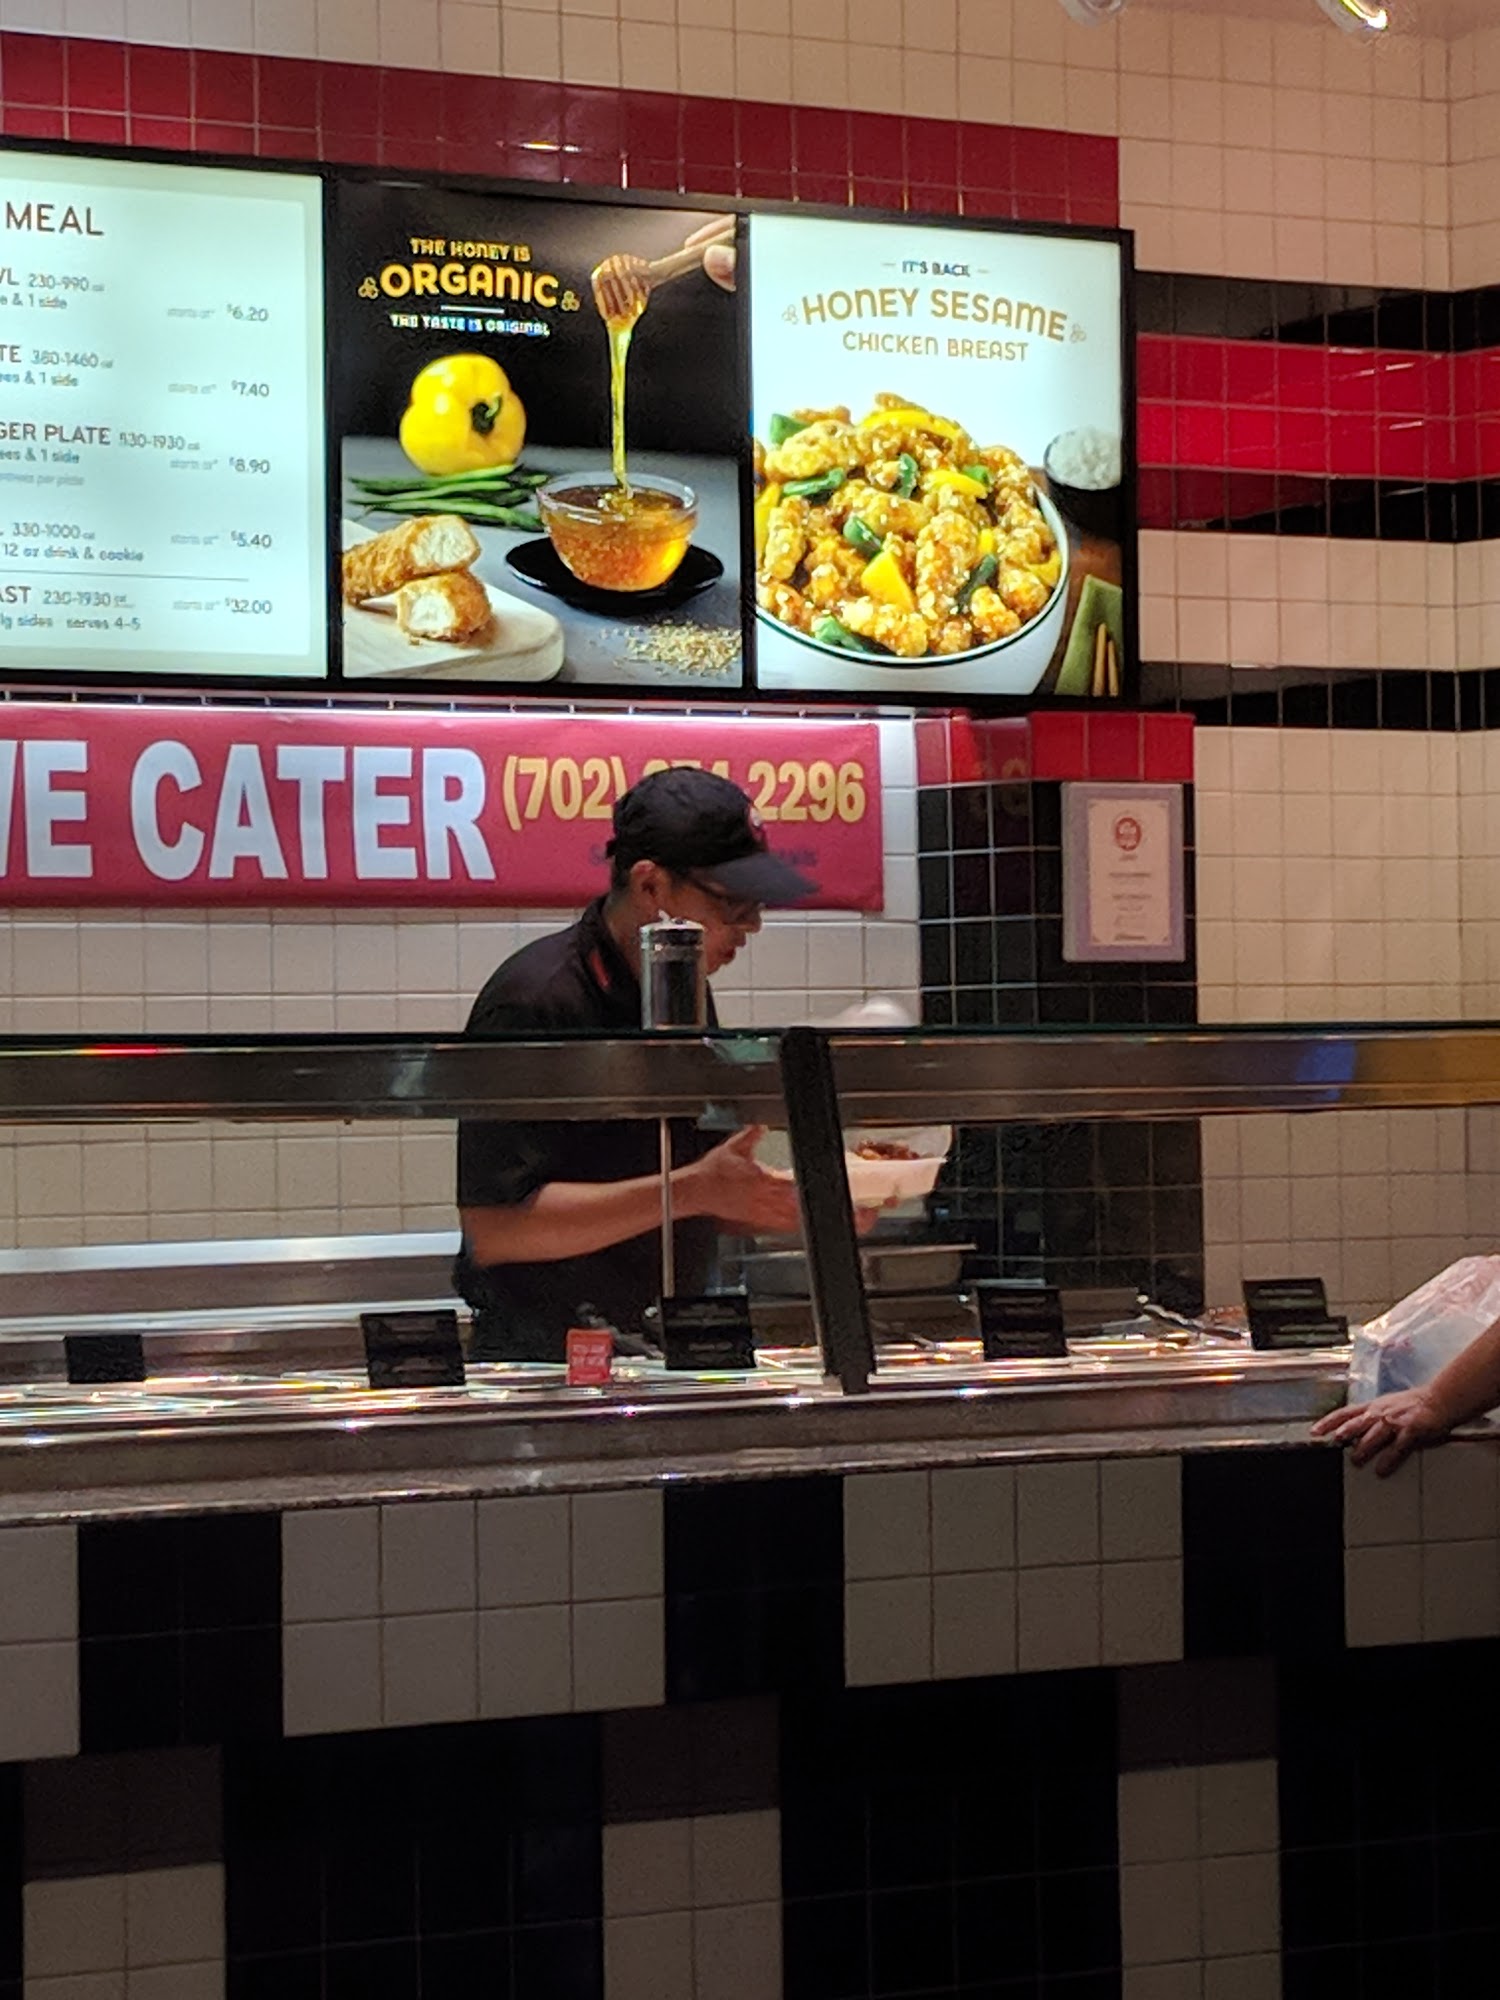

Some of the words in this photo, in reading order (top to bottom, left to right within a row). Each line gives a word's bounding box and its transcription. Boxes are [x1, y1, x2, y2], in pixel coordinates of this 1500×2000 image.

[5, 201, 105, 236] MEAL
[410, 237, 446, 257] THE
[450, 240, 511, 261] HONEY
[513, 245, 532, 263] IS
[902, 259, 928, 275] IT'S
[932, 262, 971, 278] BACK
[380, 261, 560, 309] ORGANIC
[226, 303, 270, 322] $6.20
[802, 287, 920, 326] HONEY
[930, 288, 1069, 342] SESAME
[389, 313, 419, 329] THE
[422, 314, 466, 332] TASTE
[467, 317, 483, 333] IS
[485, 318, 551, 339] ORIGINAL
[842, 330, 939, 356] CHICKEN
[947, 337, 1029, 363] BREAST
[231, 379, 270, 398] $7.40
[44, 424, 112, 446] PLATE
[52, 449, 81, 464] side
[229, 456, 271, 474] $8.90
[231, 530, 273, 549] $5.40
[502, 755, 627, 831] (702)
[0, 740, 94, 878] E
[131, 740, 496, 880] CATER
